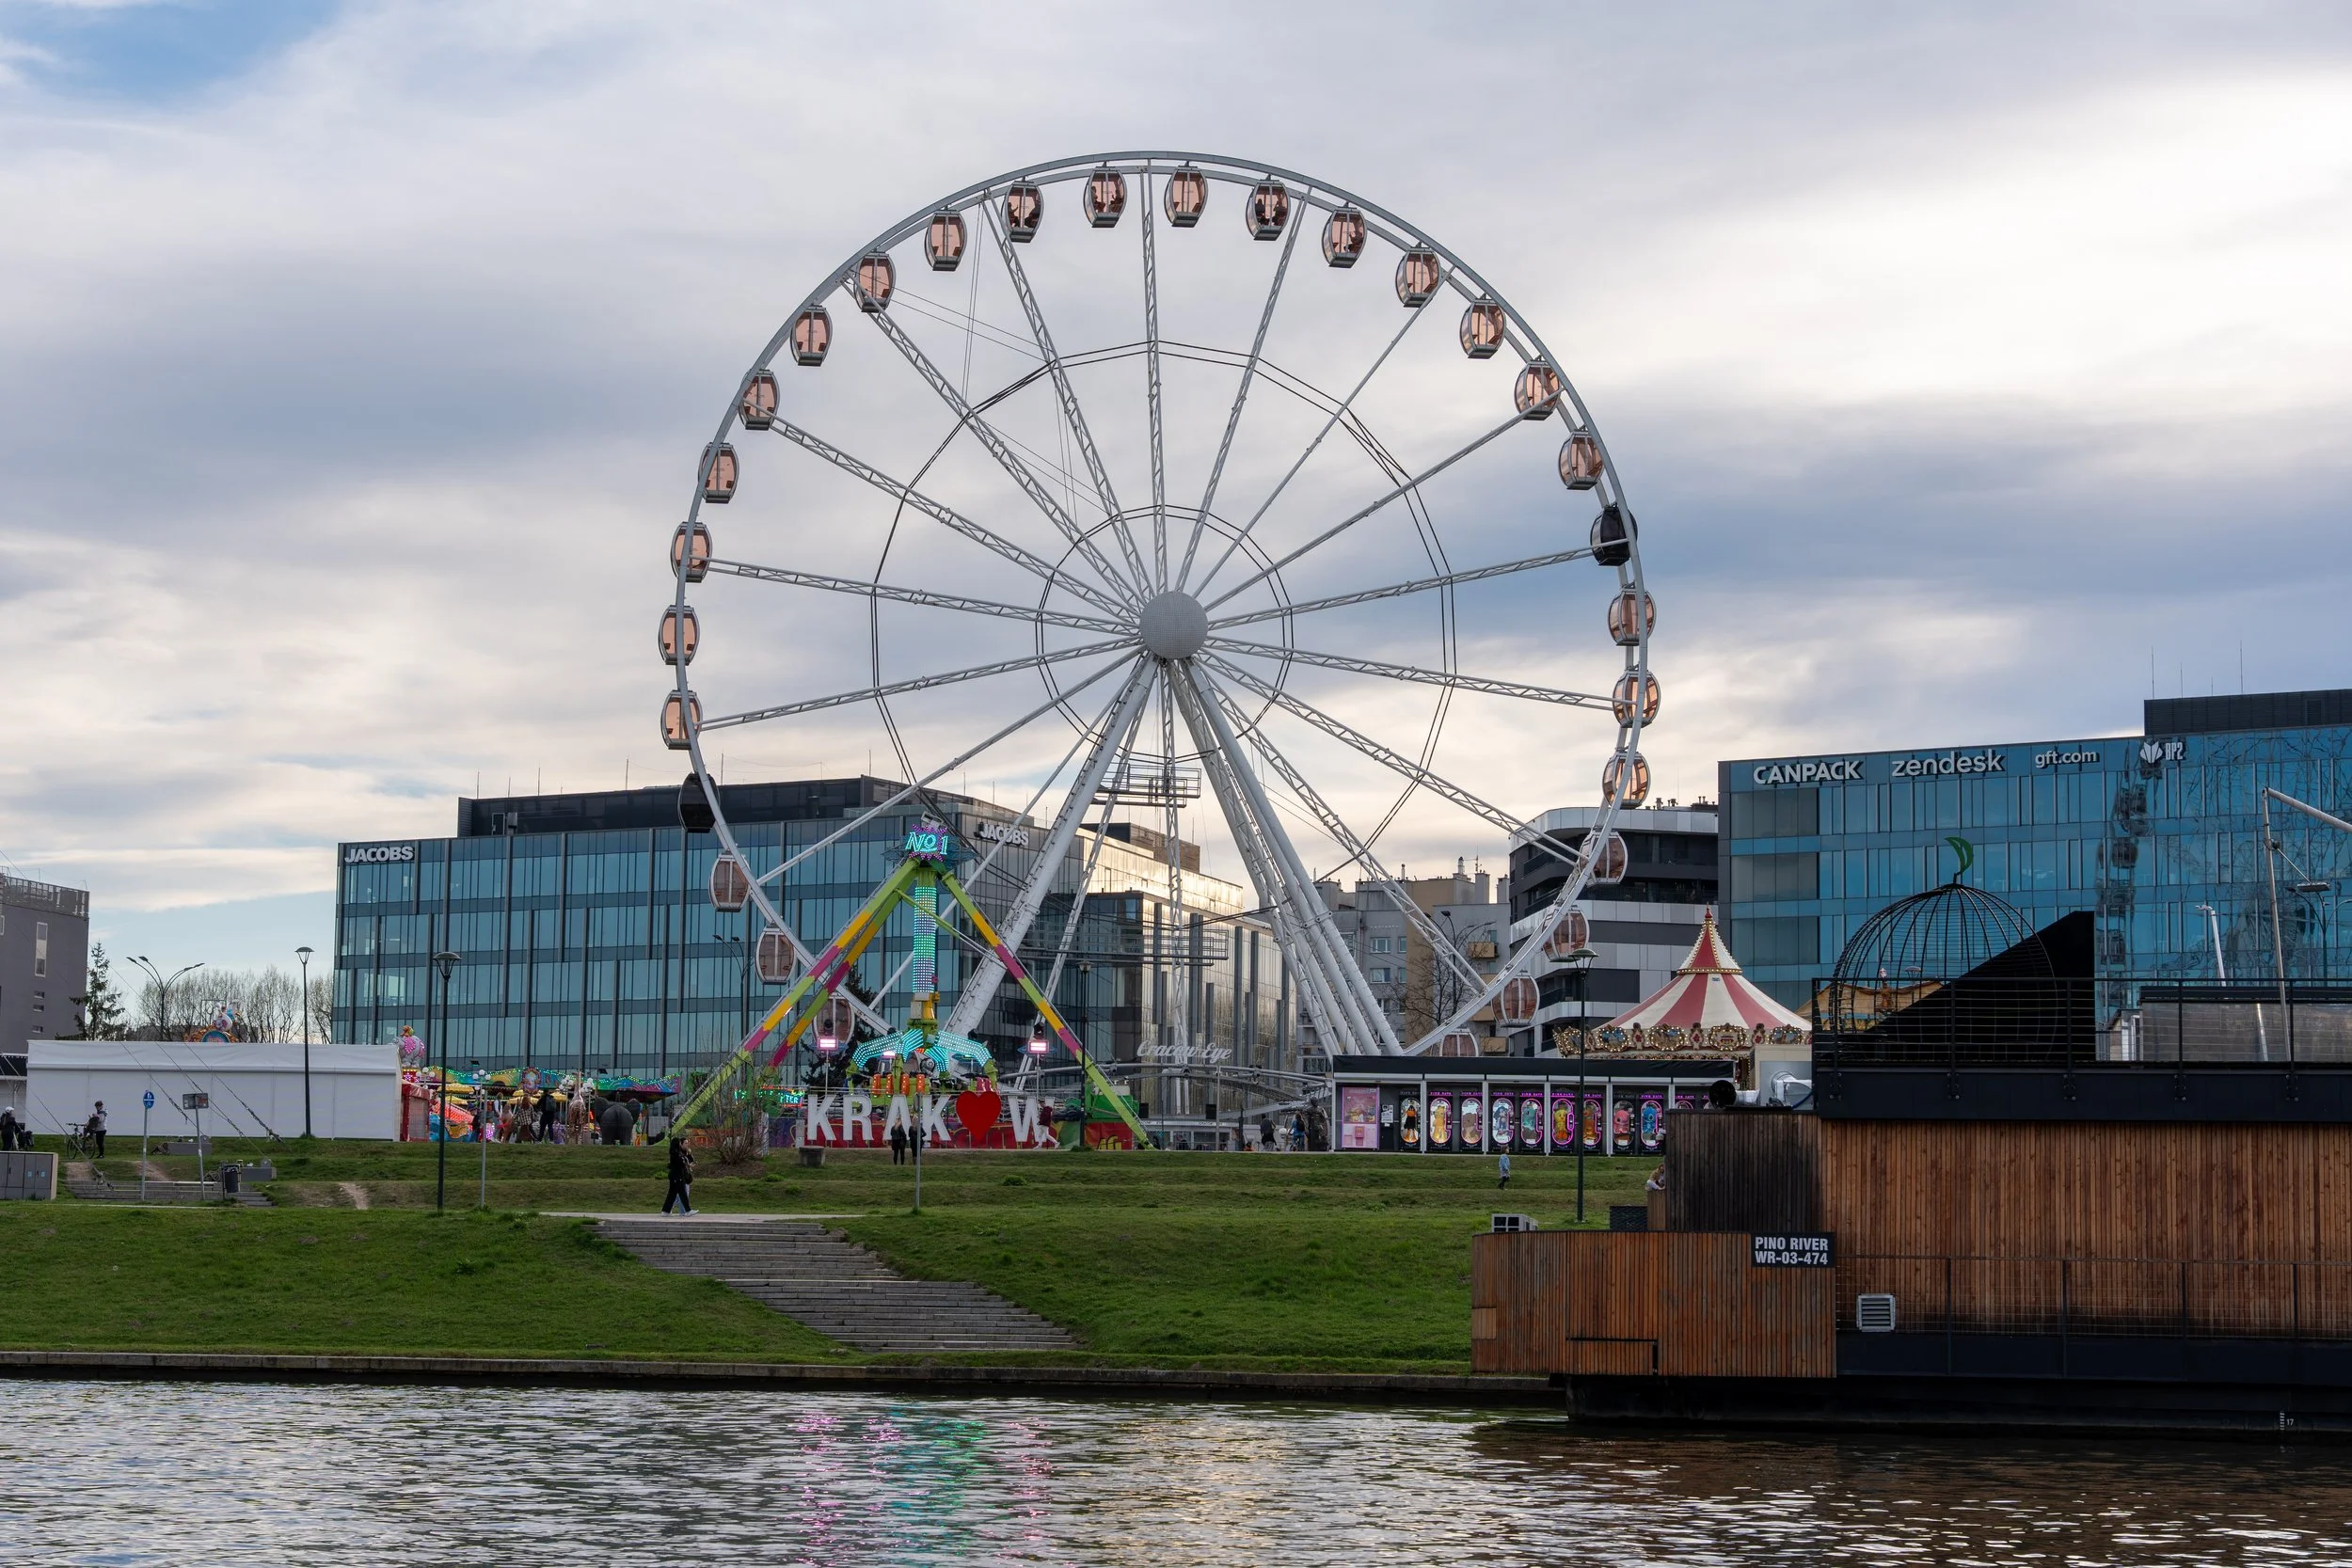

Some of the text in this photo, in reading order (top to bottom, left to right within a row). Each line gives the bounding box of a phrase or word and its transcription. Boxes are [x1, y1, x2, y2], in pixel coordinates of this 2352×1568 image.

[2034, 750, 2097, 768] gft.com
[2165, 741, 2184, 761] BP2
[1753, 760, 1862, 784] CANPACK
[1891, 748, 2003, 777] zendesk
[979, 823, 1029, 847] JACOBS
[344, 846, 414, 863] JACOBS
[1136, 1040, 1232, 1064] Cracow Eye
[1755, 1236, 1829, 1251] PINO RIVER
[1755, 1250, 1829, 1265] WR-03-474
